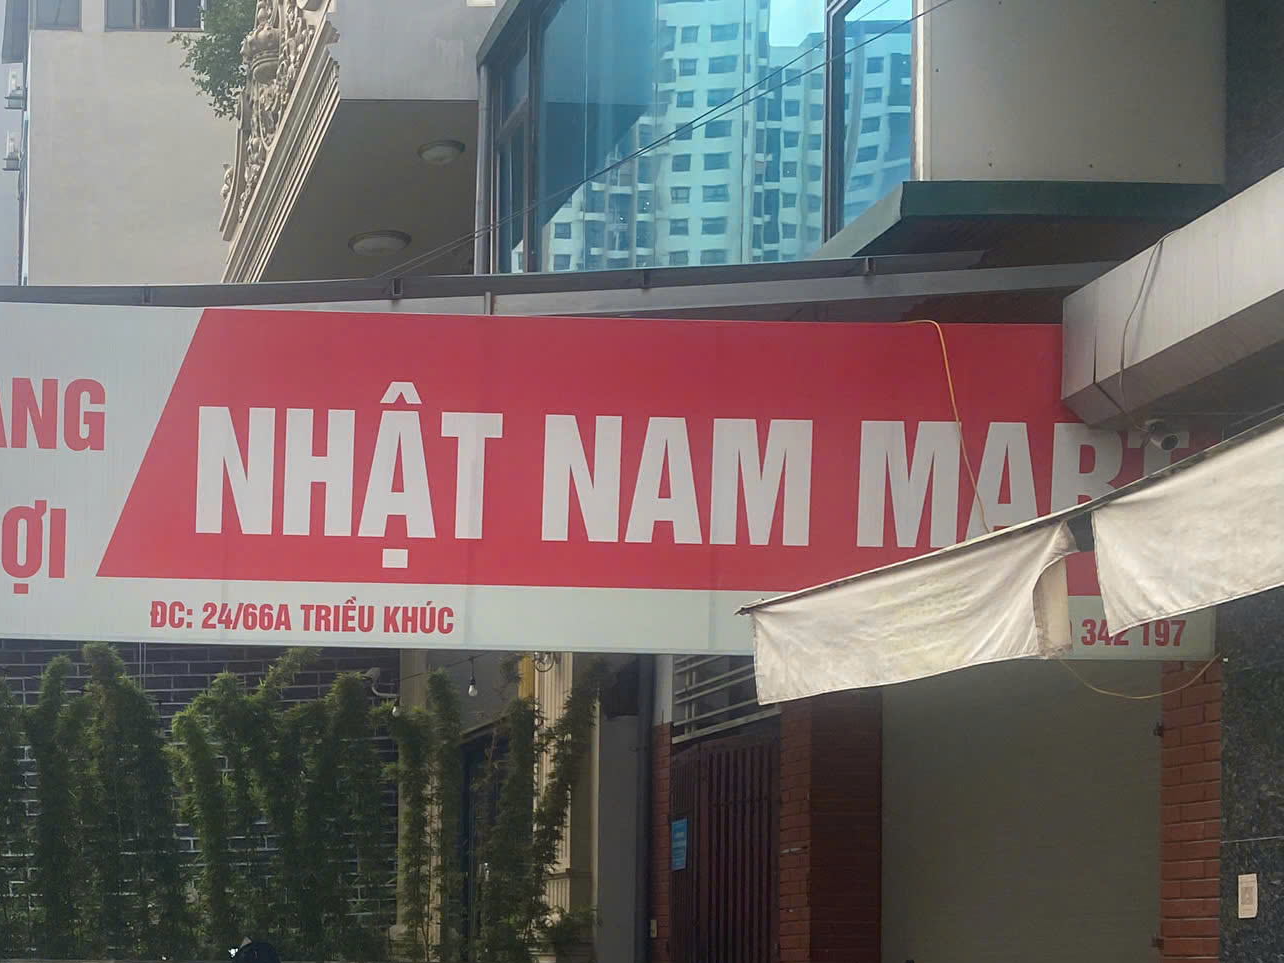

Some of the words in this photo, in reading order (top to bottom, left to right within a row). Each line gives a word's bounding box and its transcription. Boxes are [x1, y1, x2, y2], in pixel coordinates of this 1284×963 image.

[195, 381, 503, 569] NHẬT
[541, 413, 814, 548] NAM
[150, 600, 194, 630] ĐC:
[201, 600, 293, 633] 24/66A
[300, 595, 375, 634] TRIỀU
[383, 599, 455, 636] KHÚC
[1141, 619, 1186, 647] 197
